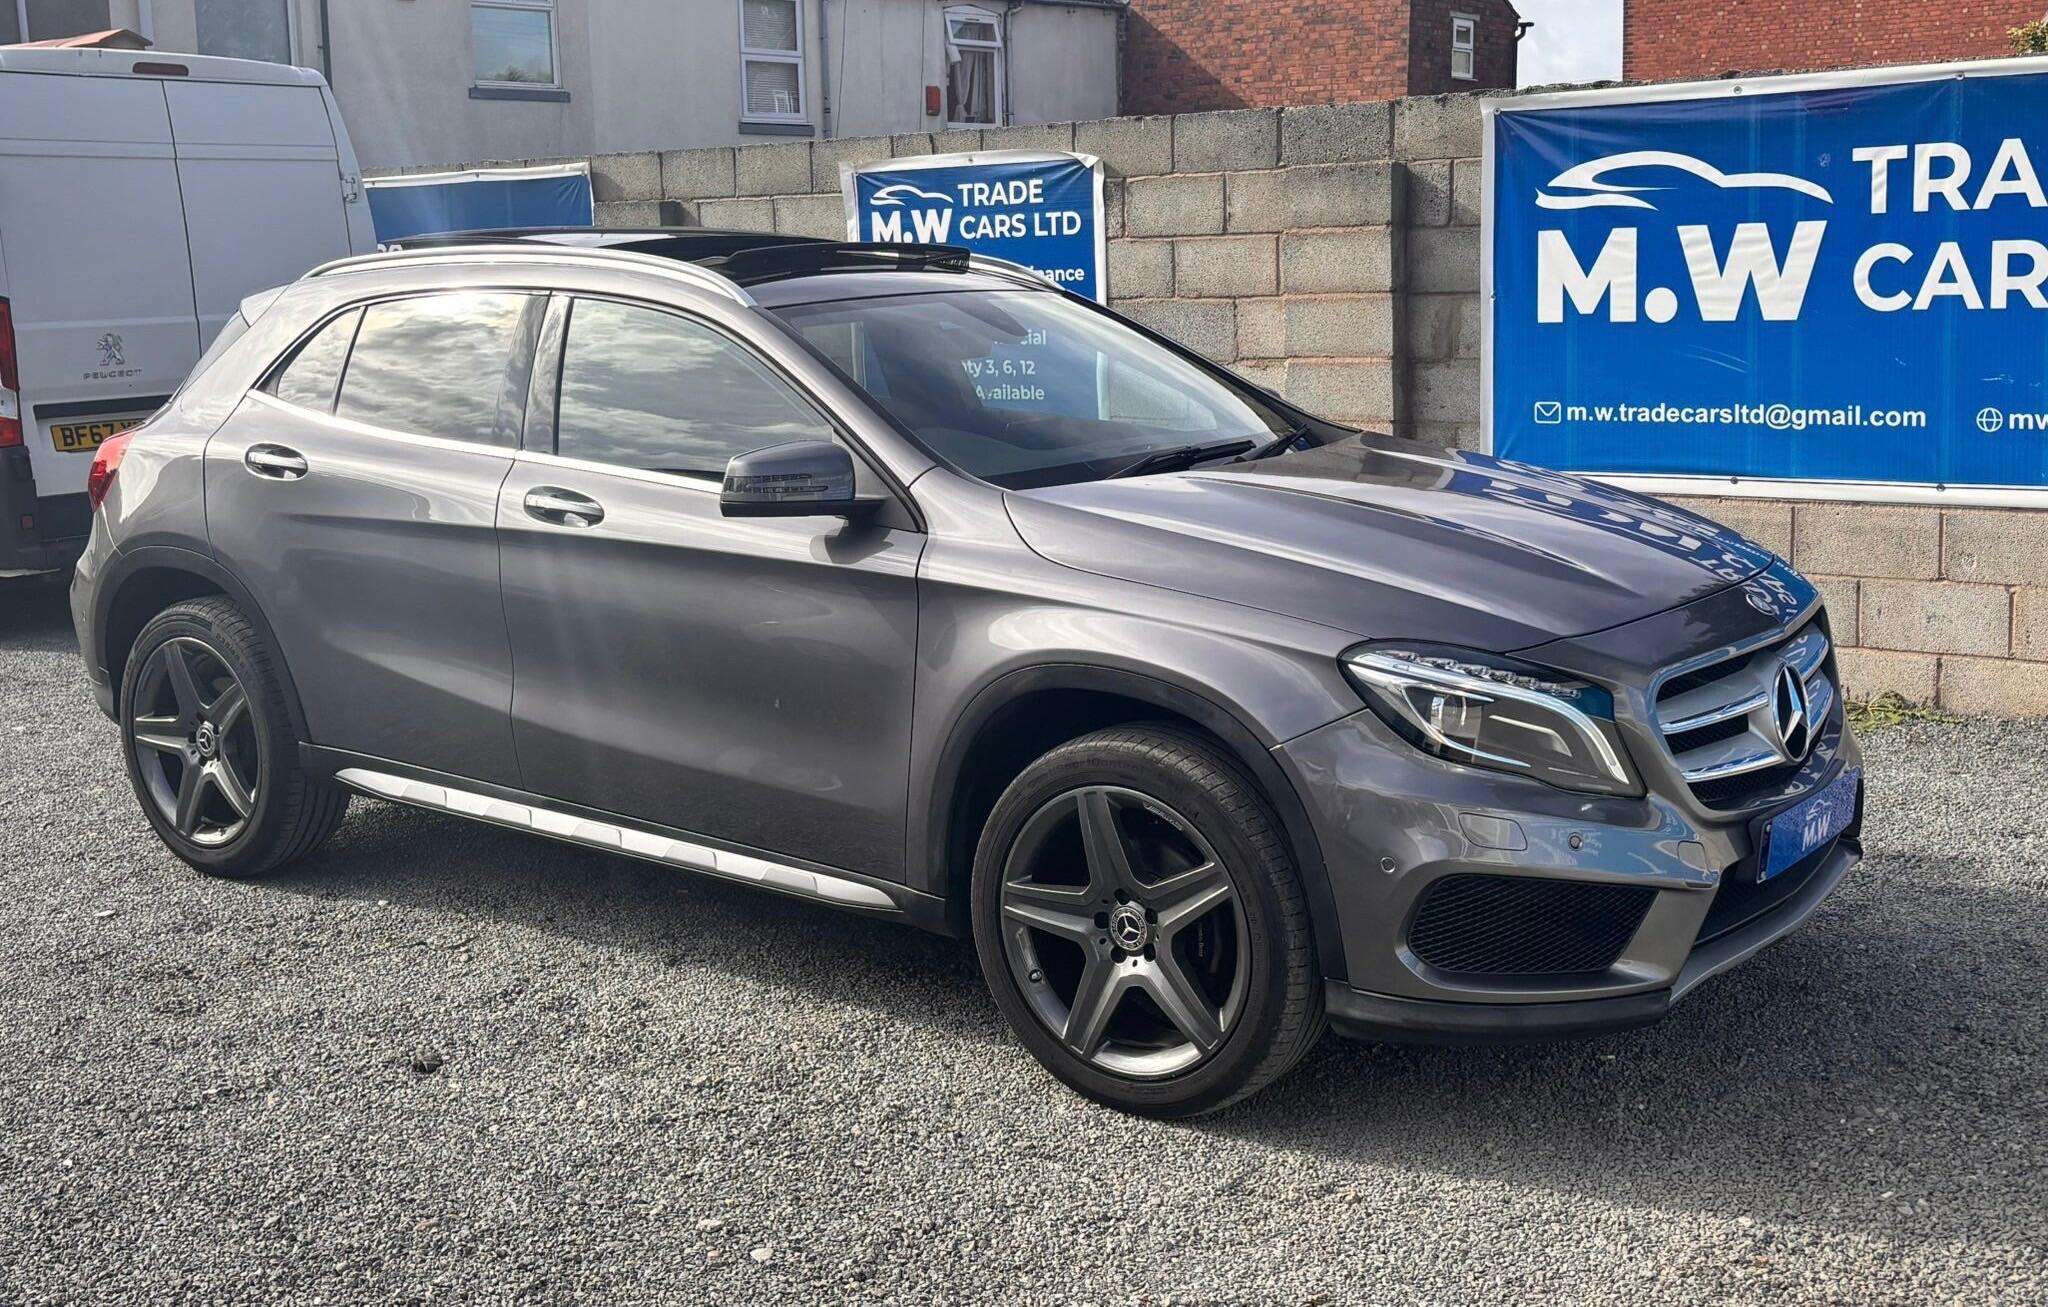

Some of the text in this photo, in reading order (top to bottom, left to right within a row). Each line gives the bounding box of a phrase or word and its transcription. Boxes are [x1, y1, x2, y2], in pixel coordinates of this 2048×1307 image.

[1852, 138, 2048, 215] TRA
[958, 179, 1044, 207] TRADE
[871, 208, 953, 244] M.W
[959, 211, 1082, 240] CARS LTD
[1537, 220, 1828, 324] M.W
[1853, 239, 2048, 313] CAR
[82, 368, 142, 380] PEUGEOT
[1002, 359, 1017, 377] 6,
[1020, 360, 1036, 375] 12
[976, 384, 1046, 400] Aailable
[1566, 402, 1927, 430] m.w.tradecarsltd@gmail.com
[60, 423, 115, 447] BF67
